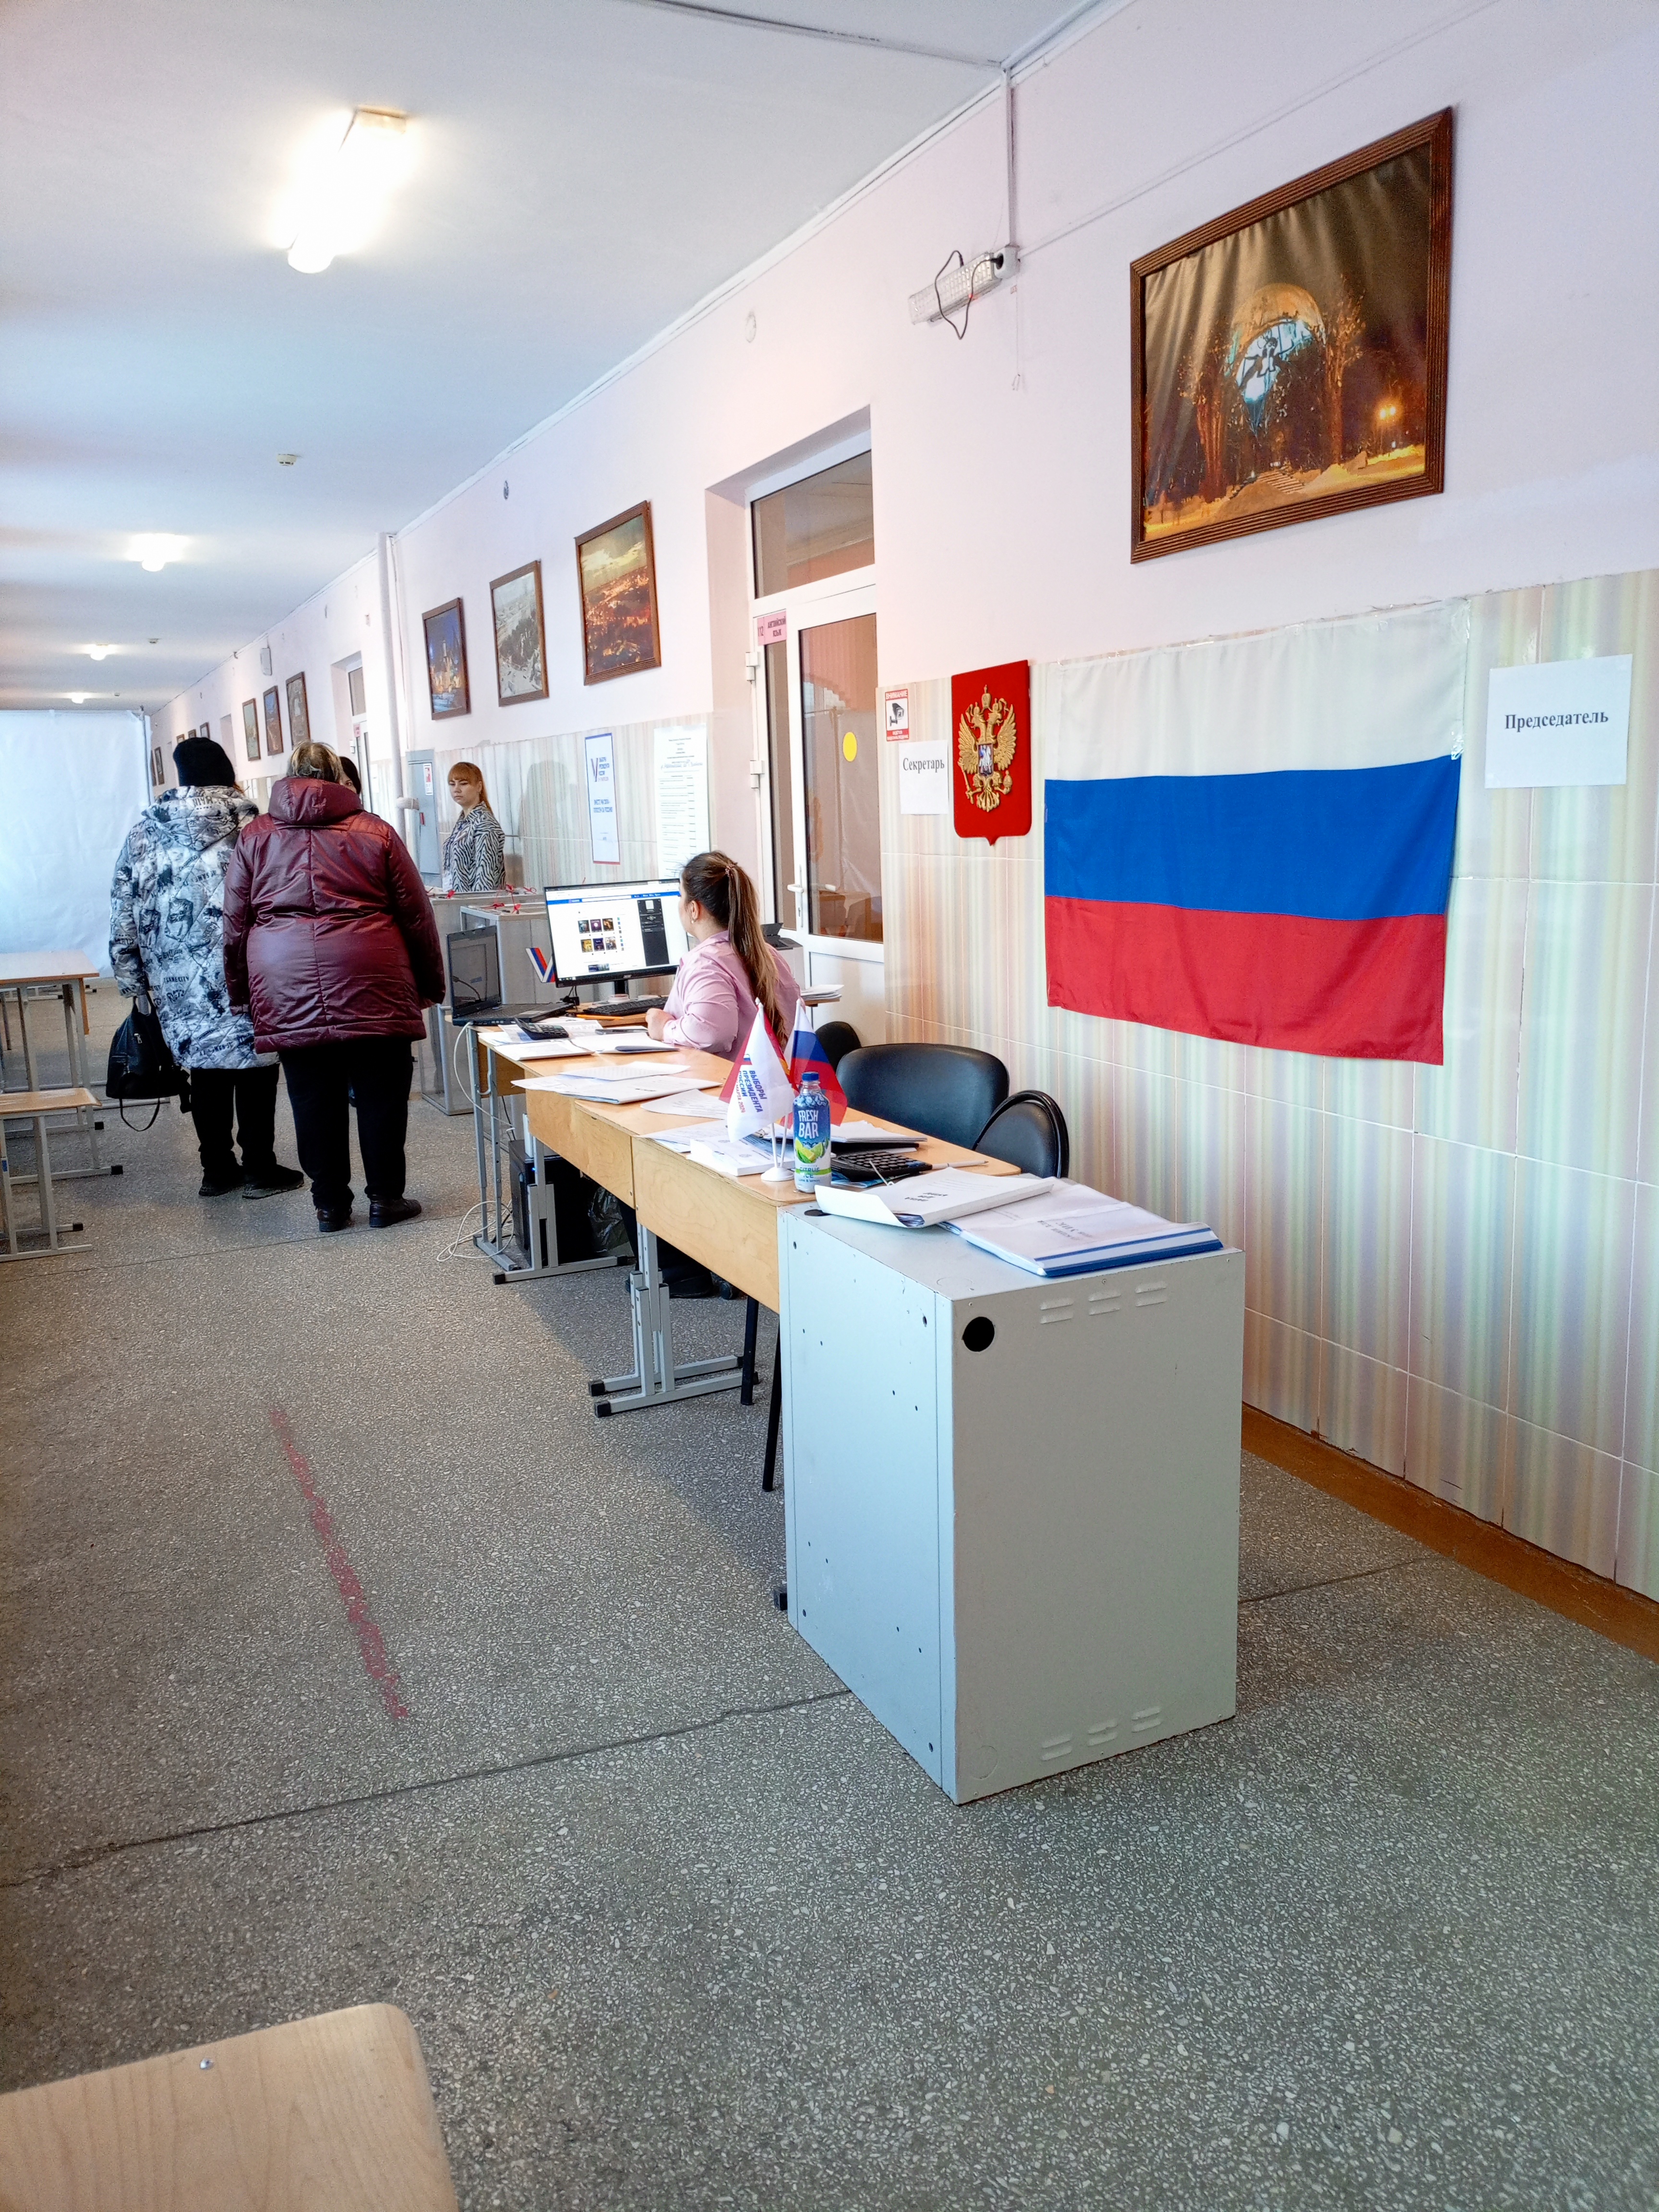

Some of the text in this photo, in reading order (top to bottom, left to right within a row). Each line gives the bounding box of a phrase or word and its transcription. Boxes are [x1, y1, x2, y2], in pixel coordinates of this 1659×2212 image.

[1504, 712, 1609, 733] Председатель
[903, 757, 945, 774] Секретарь
[742, 1070, 763, 1113] ПРЕЗИДЕНТА
[749, 1070, 768, 1099] ВЫБОРЫ
[798, 1109, 819, 1122] FRESH
[798, 1122, 819, 1140] BAR
